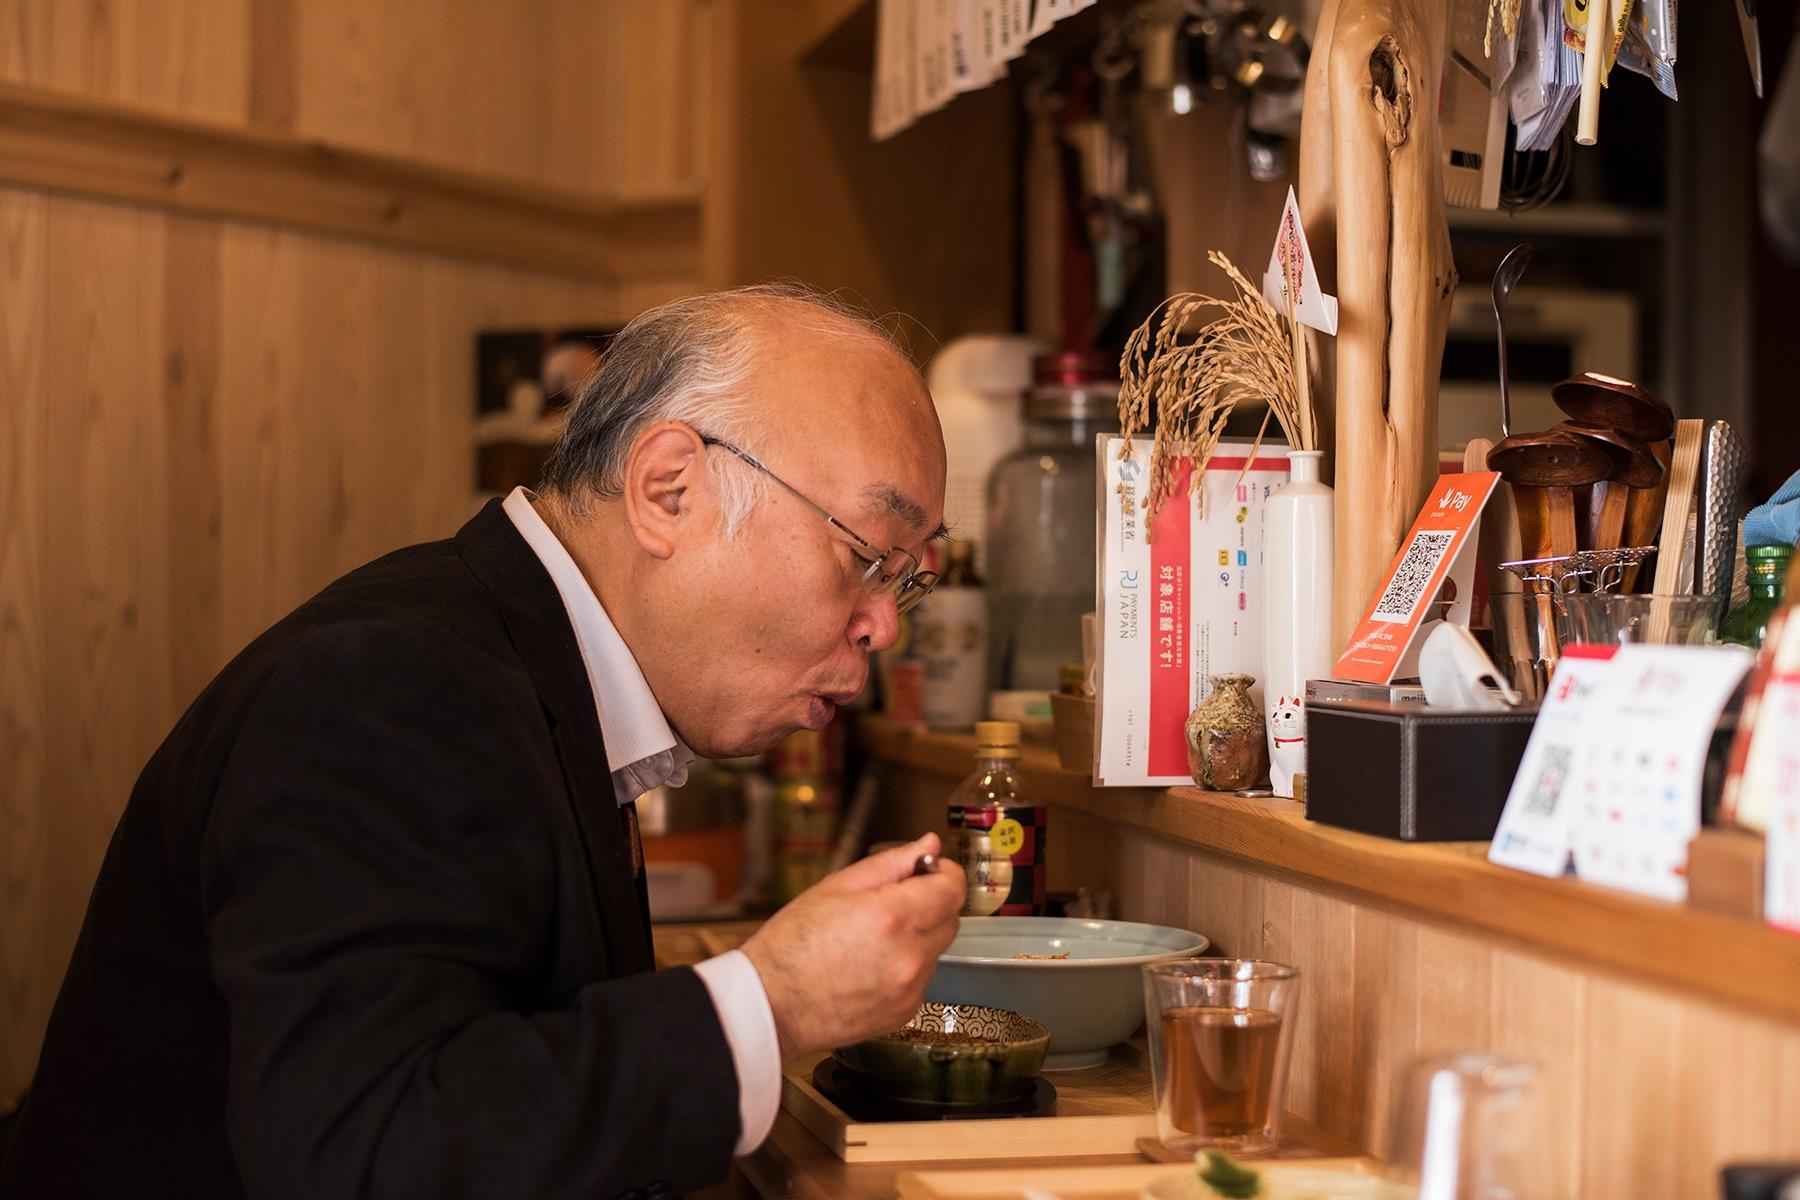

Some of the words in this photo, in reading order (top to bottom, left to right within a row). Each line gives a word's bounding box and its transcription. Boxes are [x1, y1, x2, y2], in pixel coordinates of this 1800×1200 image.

[1448, 491, 1473, 513] Pay
[1119, 593, 1129, 639] JAPAN
[1130, 593, 1138, 639] PAYMENTS
